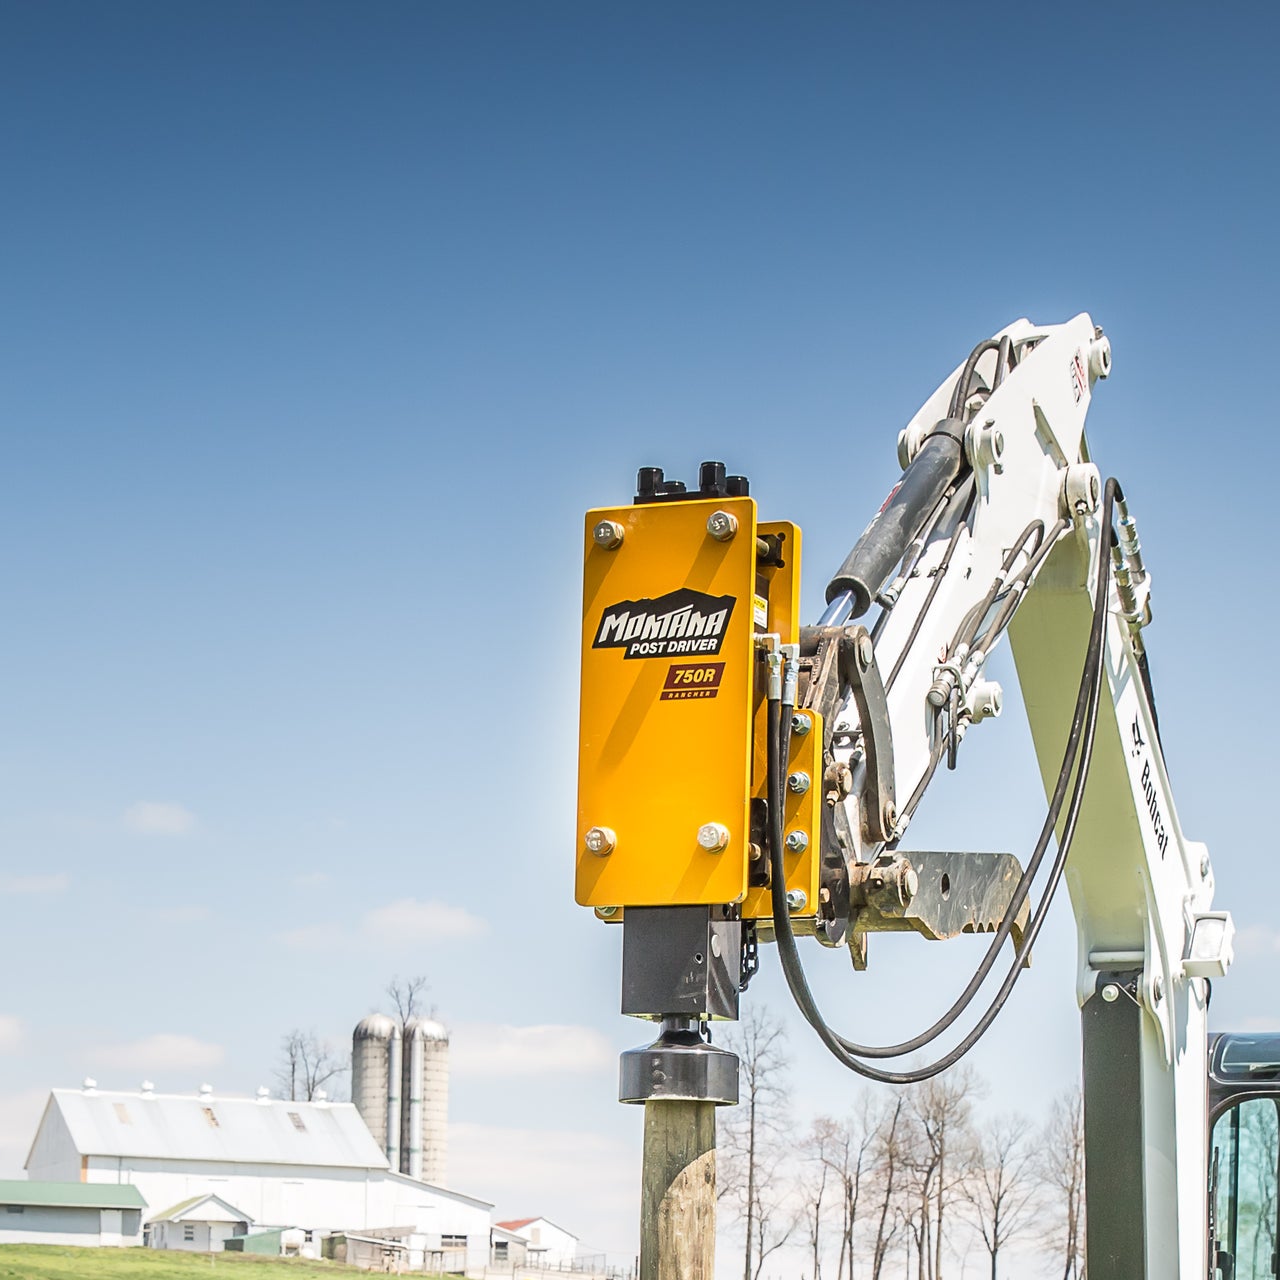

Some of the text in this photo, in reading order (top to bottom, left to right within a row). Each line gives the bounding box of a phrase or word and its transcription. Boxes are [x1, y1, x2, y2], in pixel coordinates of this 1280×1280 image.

[630, 638, 718, 655] POST DRIVER
[673, 668, 716, 684] 750R
[668, 690, 711, 699] RANCHER
[1141, 758, 1168, 861] Bobcat
